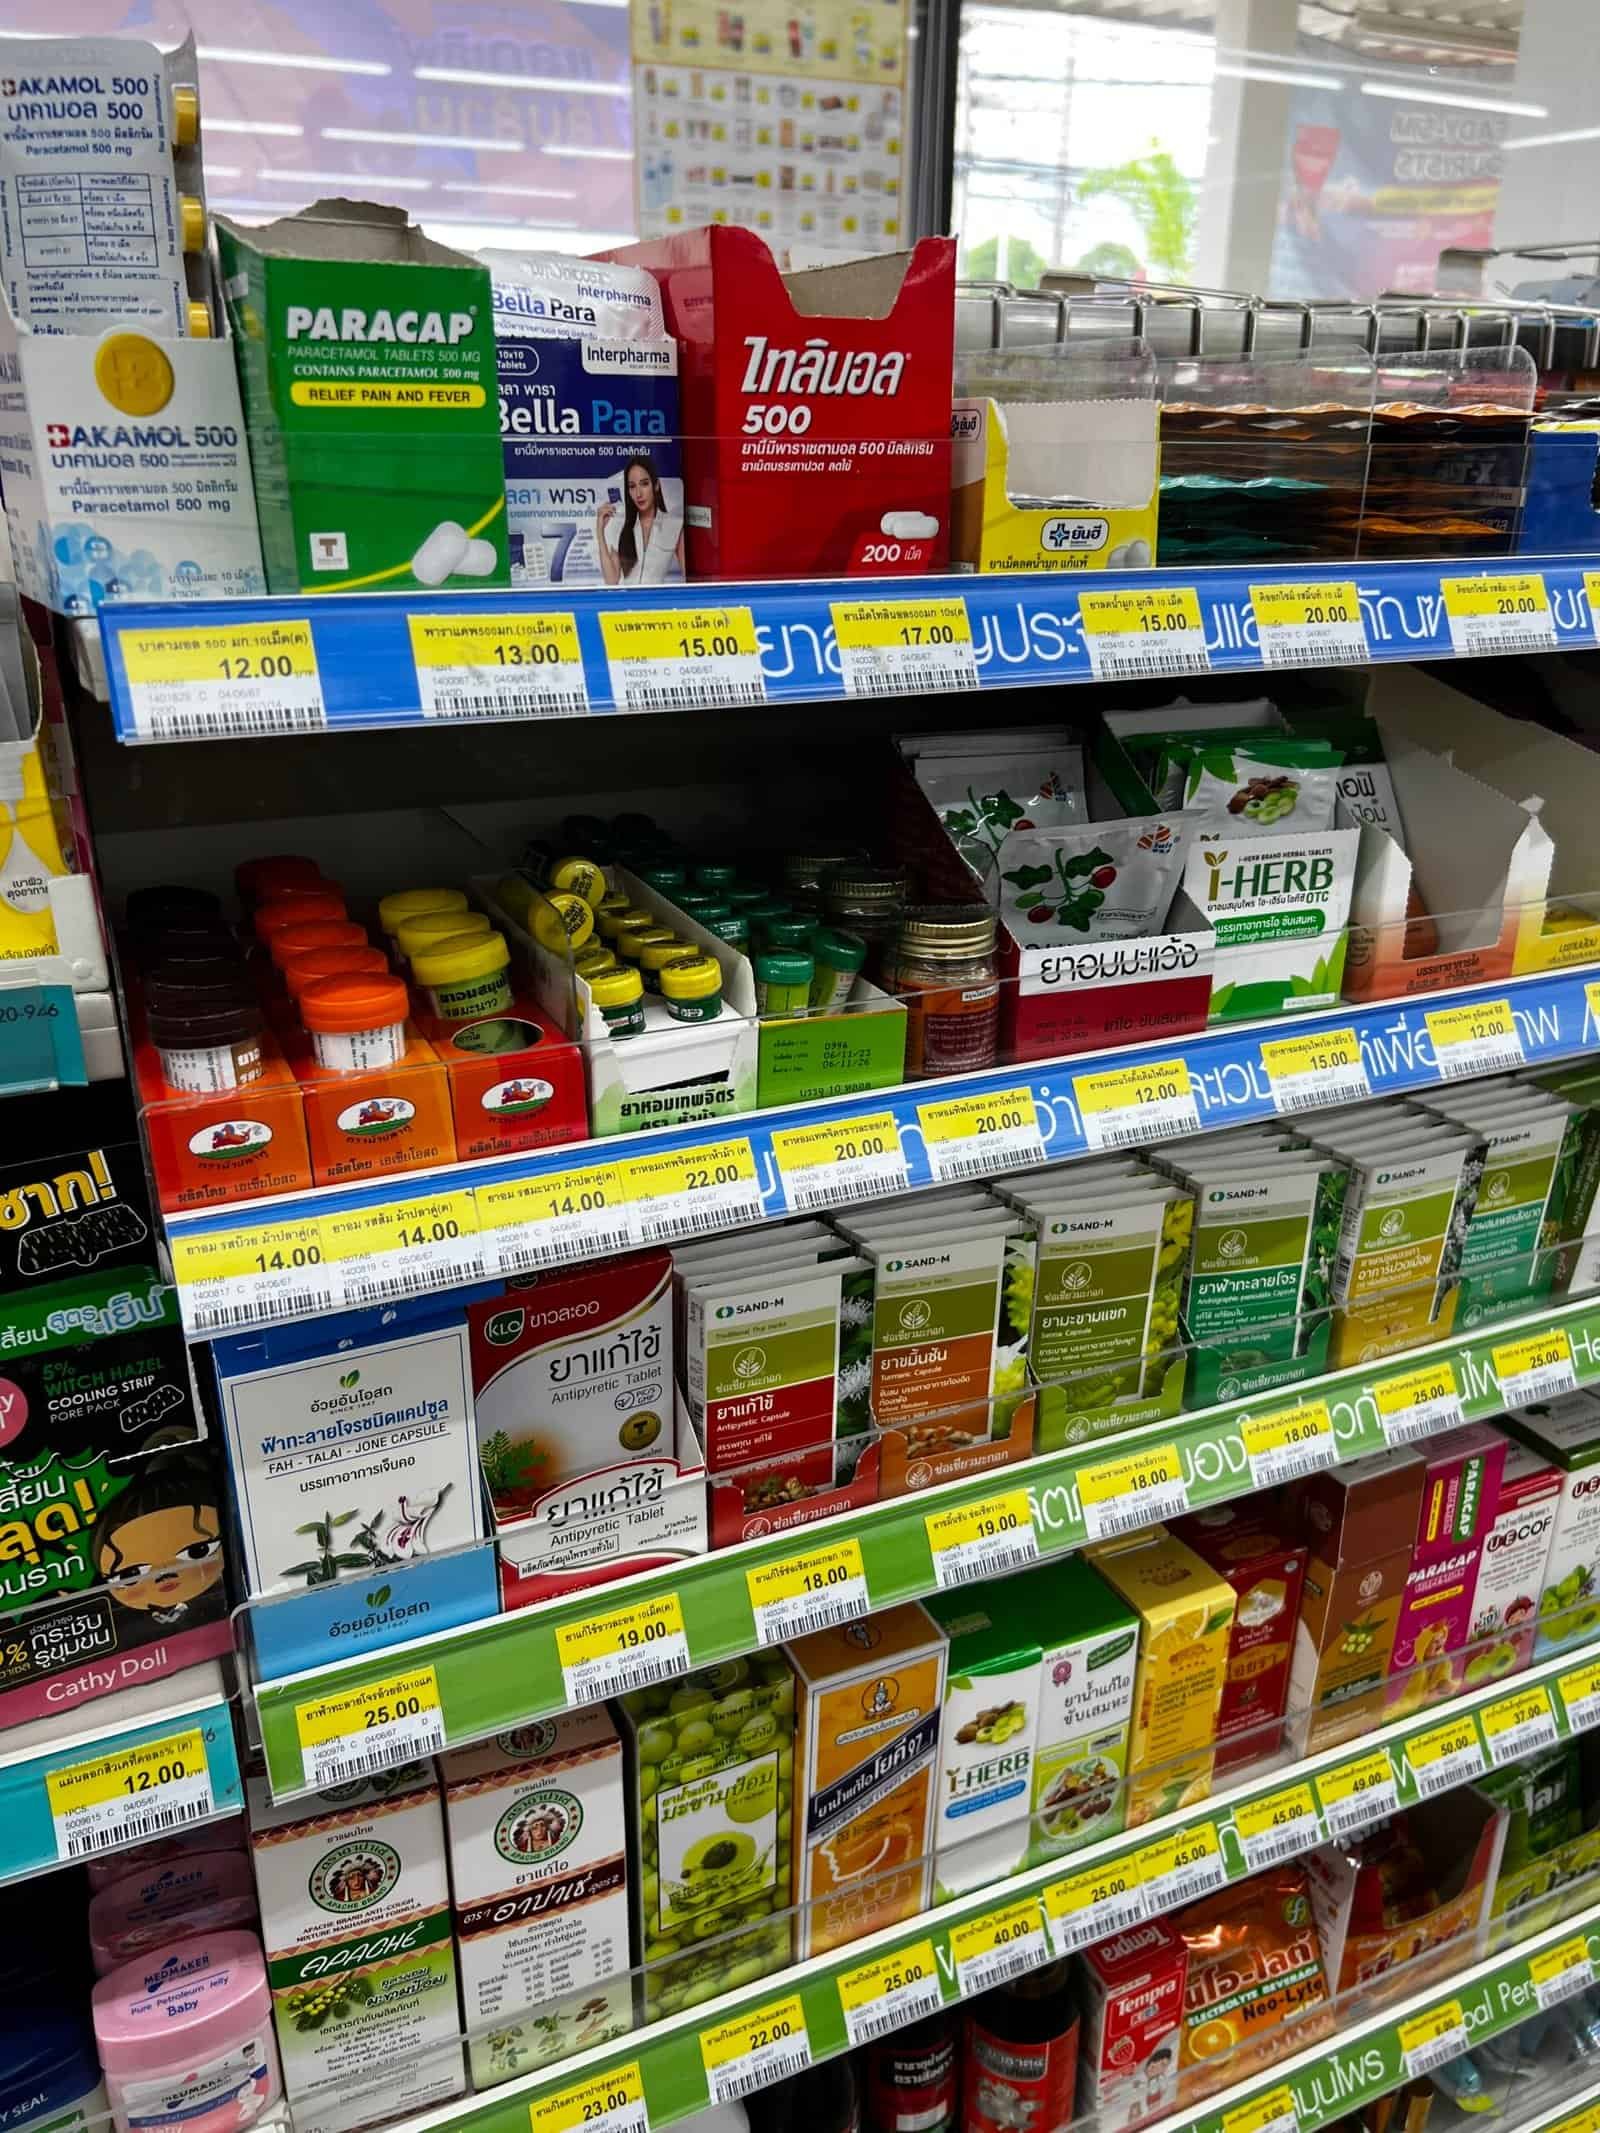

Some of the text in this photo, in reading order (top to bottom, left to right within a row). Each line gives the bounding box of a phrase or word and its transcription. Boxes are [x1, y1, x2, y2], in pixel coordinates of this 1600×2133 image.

[112, 78, 148, 96] 500
[8, 102, 143, 120] บาคามอล 500
[26, 144, 132, 157] Paracetamol 500 mg
[491, 283, 652, 325] Bella Para Interpharma
[287, 306, 473, 346] PARACAP
[287, 346, 481, 363] PARACETAMOL TABLETS 500 MG
[587, 346, 671, 366] Interpharma
[741, 336, 905, 396] ไทลินอล
[294, 364, 480, 383] CONTAINS PARACETAMOL 500 mg
[308, 389, 472, 404] RELIEF PAIN AND FEVER
[524, 384, 556, 397] พารา
[592, 402, 666, 435] Para
[741, 405, 812, 434] 500
[47, 424, 238, 448] BAKAMOL 500
[598, 446, 615, 457] 500
[859, 441, 885, 456] 500
[52, 453, 135, 469] บาคามอล
[140, 453, 169, 468] 500
[72, 499, 231, 513] Paracetamol 500 mg
[548, 486, 596, 505] พารา
[1071, 525, 1102, 544] ยันฮี
[541, 523, 577, 583] 7
[862, 544, 900, 564] 200
[1304, 605, 1348, 624] 20.00
[1497, 597, 1536, 615] 20.00
[1140, 613, 1187, 633] 15.00
[679, 636, 739, 660] 15.00
[900, 625, 954, 647] 17.00
[494, 643, 560, 666] 13.00
[219, 655, 293, 680] 12.00
[1282, 847, 1334, 860] HERBAL TABLETS
[1306, 891, 1329, 906] OTC
[1040, 939, 1199, 985] ยาอมมะแว้ง
[1470, 1022, 1506, 1040] 12.00
[1309, 1050, 1349, 1072] 15.00
[620, 1086, 735, 1119] ยาหอมเทพจิตร
[1135, 1082, 1178, 1105] 12.00
[976, 1111, 1022, 1135] 20.00
[468, 1137, 513, 1156] ผลิตโดย
[834, 1137, 884, 1162] 20.00
[1499, 1131, 1531, 1145] SAND-M
[327, 1159, 374, 1178] ผลิตโดย
[686, 1163, 740, 1191] 22.00
[1391, 1167, 1427, 1181] SAND-M
[177, 1184, 228, 1204] ผลิตโดย
[487, 1190, 515, 1204] ยาอม
[548, 1190, 606, 1218] 14.00
[1226, 1188, 1268, 1200] SAND-M
[332, 1220, 363, 1234] ยาอม
[397, 1219, 459, 1248] 14.00
[1069, 1219, 1114, 1231] SAND-M
[186, 1242, 218, 1256] ยาอม
[255, 1245, 321, 1273] 14.00
[904, 1254, 951, 1269] SAND-M
[1198, 1271, 1297, 1295] ยาฟ้าทะลายโจร
[530, 1300, 600, 1330] ขาวละออ
[735, 1296, 785, 1315] SAND-M
[1041, 1307, 1128, 1330] ยามะขามแขก
[549, 1325, 662, 1382] ยาแก้ไข้
[881, 1347, 948, 1371] ยาขมิ้นชัน
[1529, 1350, 1560, 1369] 25.00
[44, 1356, 165, 1398] WITCH HAZEL
[551, 1365, 662, 1406] Antipyretic Tablet
[47, 1374, 156, 1411] COOLING STRIP
[310, 1384, 393, 1415] อ้วยอันโอสถ
[1413, 1384, 1445, 1405] 25.00
[50, 1398, 122, 1424] PORE PACK
[717, 1392, 775, 1420] ยาแก้ไข้
[261, 1398, 450, 1456] ฟ้าทะลายโจรชนิดแคปซูล
[1283, 1422, 1319, 1444] 18.00
[268, 1421, 447, 1475] FAH TALAI JONE CAPSULE
[299, 1455, 416, 1494] บรรเทาอาการเจ็บคอ
[1130, 1468, 1168, 1492] 18.00
[1458, 1457, 1485, 1538] PARACAP
[550, 1505, 666, 1550] Antipyretic Tablet
[976, 1513, 1018, 1539] 19.00
[803, 1565, 848, 1592] 18.00
[1406, 1549, 1478, 1585] PARACAP
[328, 1599, 432, 1638] อ้วยอันโอสถ
[31, 1613, 103, 1650] กระชับ
[616, 1622, 667, 1650] 19.00
[34, 1628, 111, 1668] รูขุมขน
[46, 1647, 168, 1702] Cathy Doll
[364, 1696, 420, 1729] 25.00
[1514, 1704, 1541, 1724] 37.00
[205, 1729, 216, 1743] 6
[350, 1740, 358, 1750] C
[907, 1733, 924, 1758] 97
[1440, 1736, 1469, 1756] 50.00
[124, 1761, 186, 1795] 12.00
[1353, 1772, 1382, 1793] 49.00
[106, 1807, 115, 1818] C
[1272, 1805, 1304, 1827] 45.00
[1174, 1845, 1207, 1868] 45.00
[516, 1860, 569, 1886] ยาแก้ไอ
[1091, 1878, 1126, 1903] 25.00
[993, 1920, 1030, 1945] 40.00
[144, 1954, 211, 1986] MEDMAKER
[884, 1964, 923, 1994] 25.00
[130, 2003, 154, 2017] Pure
[156, 1983, 206, 2007] Petroleum
[1116, 1979, 1177, 2018] Tempra
[1187, 1964, 1319, 2027] ELECTROLYTE BEVERAGE
[1242, 1978, 1324, 2023] Neo-Lyte
[167, 1998, 200, 2019] Baby
[750, 2020, 791, 2051] 22.00
[12, 2091, 50, 2119] SEAL
[583, 2090, 628, 2121] 23.00
